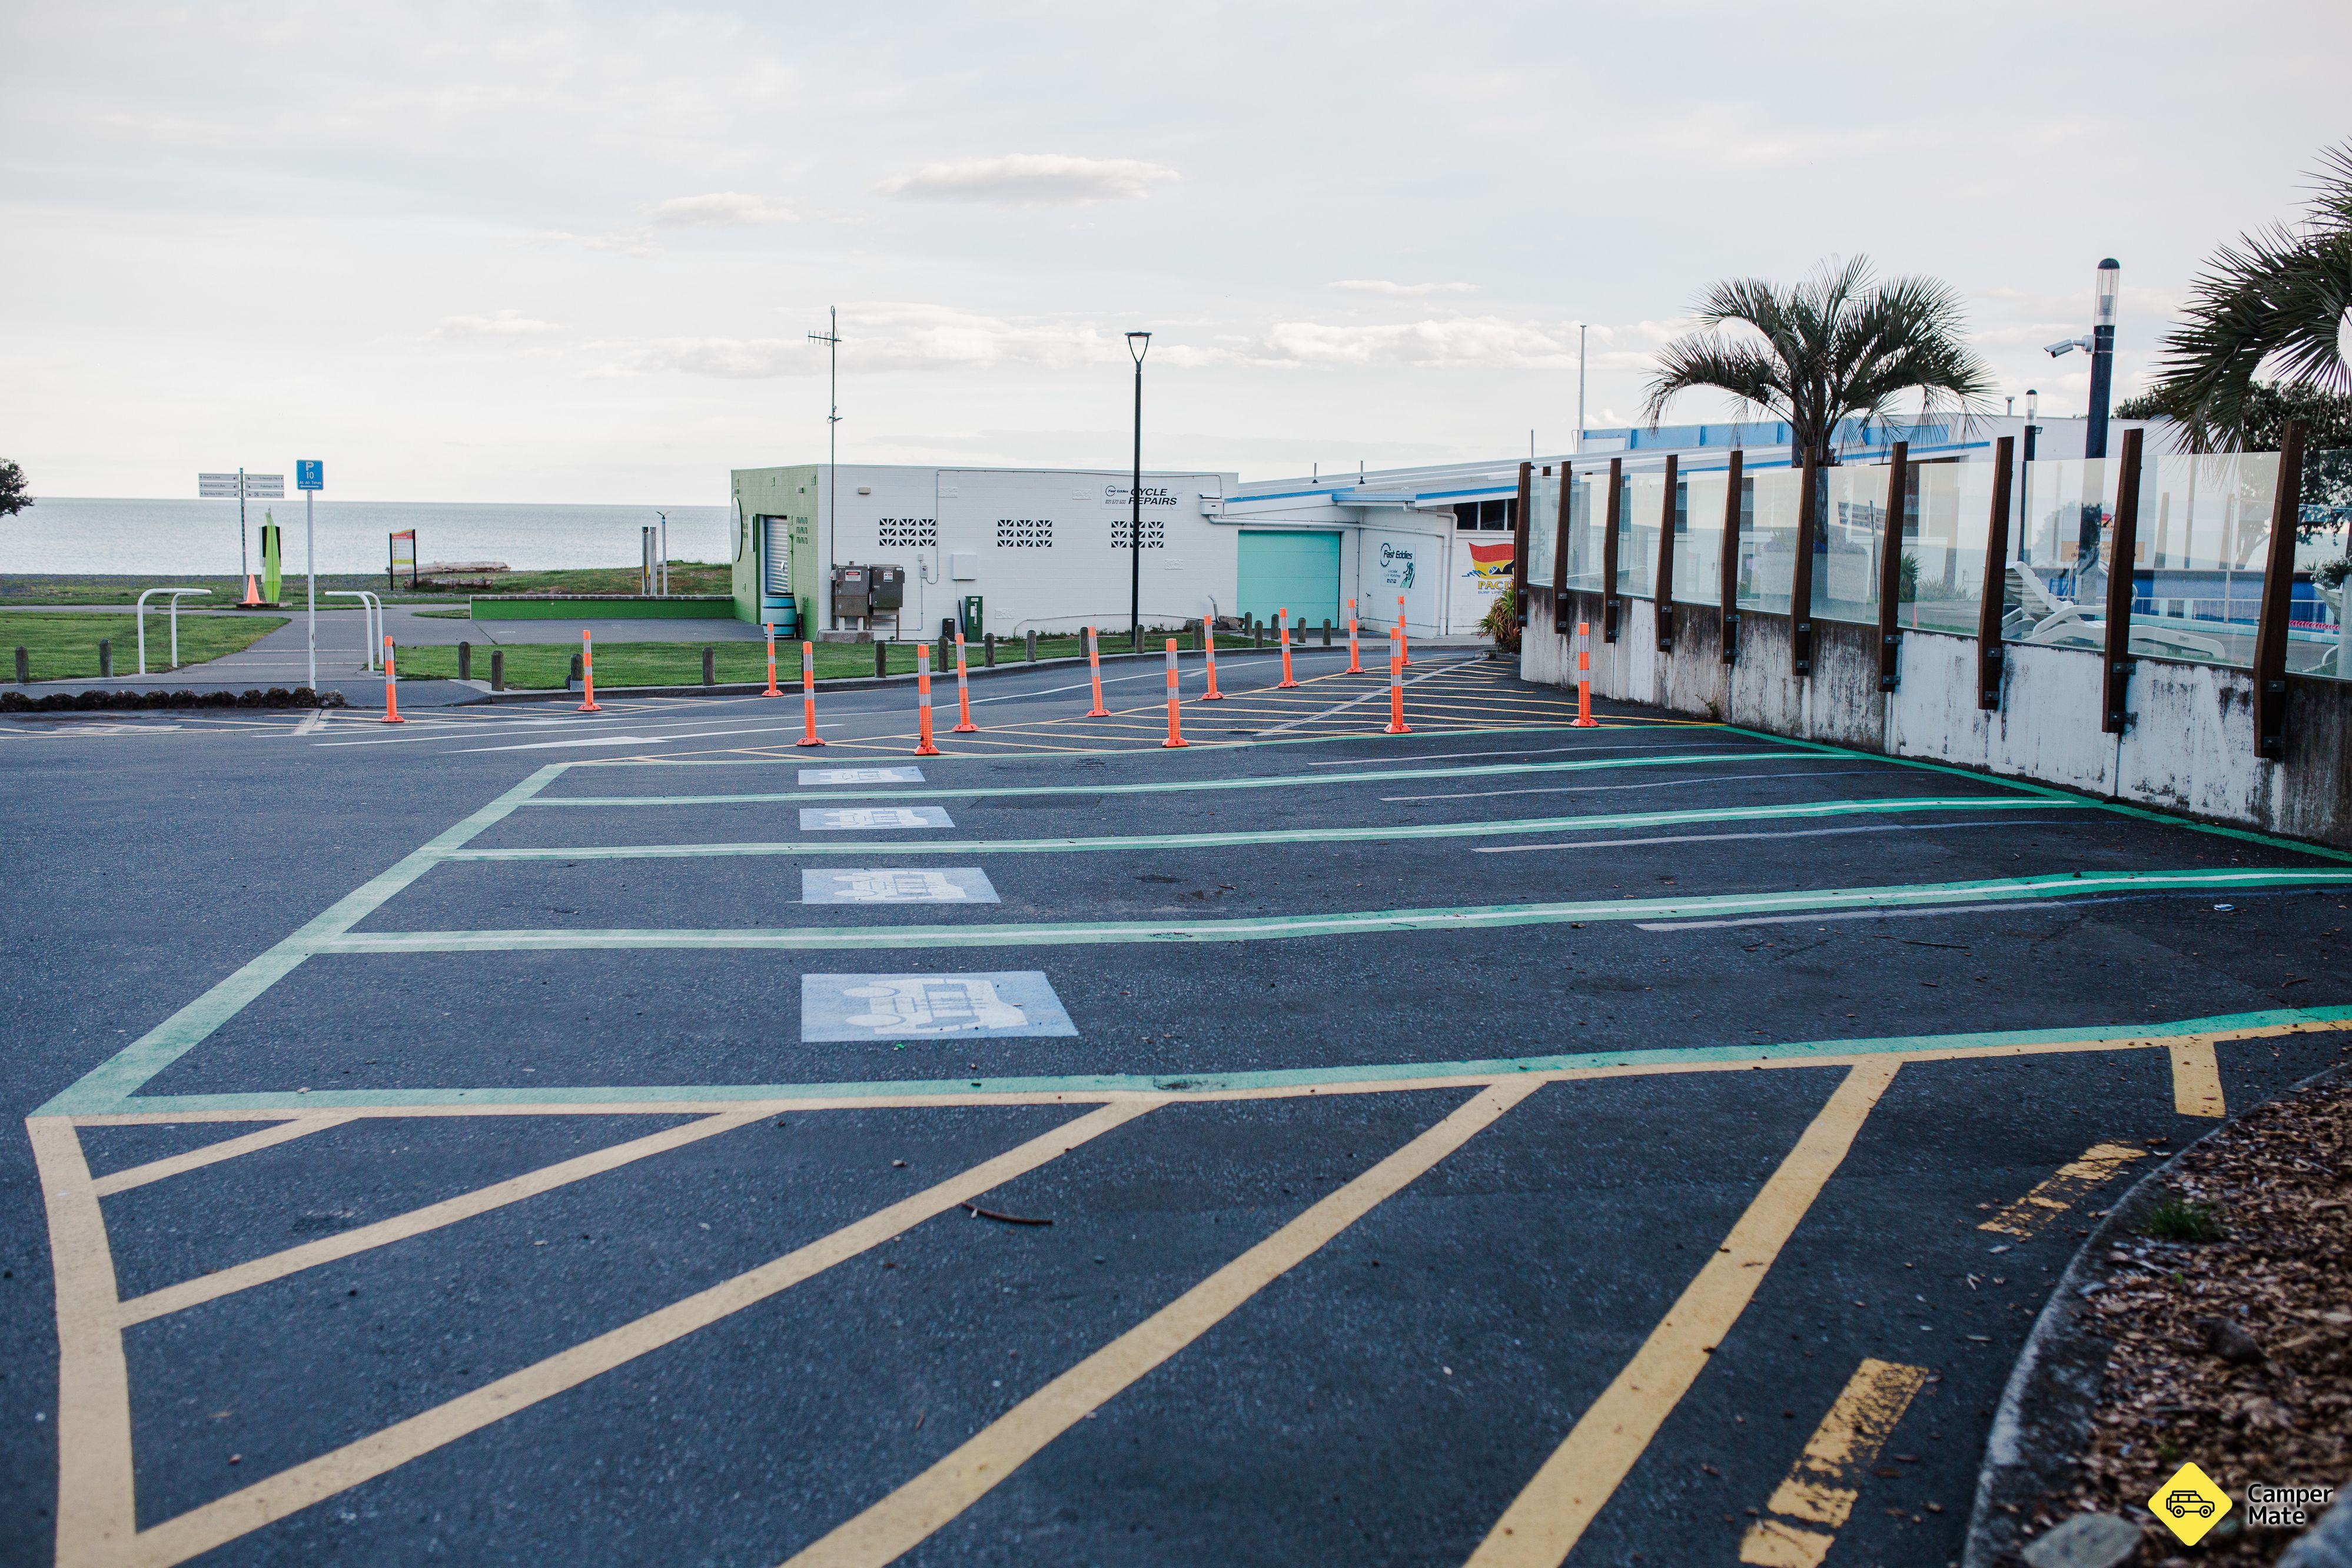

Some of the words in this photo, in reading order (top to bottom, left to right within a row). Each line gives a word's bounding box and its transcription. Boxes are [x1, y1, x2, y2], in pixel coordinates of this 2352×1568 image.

[306, 461, 314, 471] P
[306, 471, 314, 480] 10
[1383, 550, 1395, 559] Fast
[1396, 550, 1413, 560] Eddies
[1478, 580, 1511, 590] PACI
